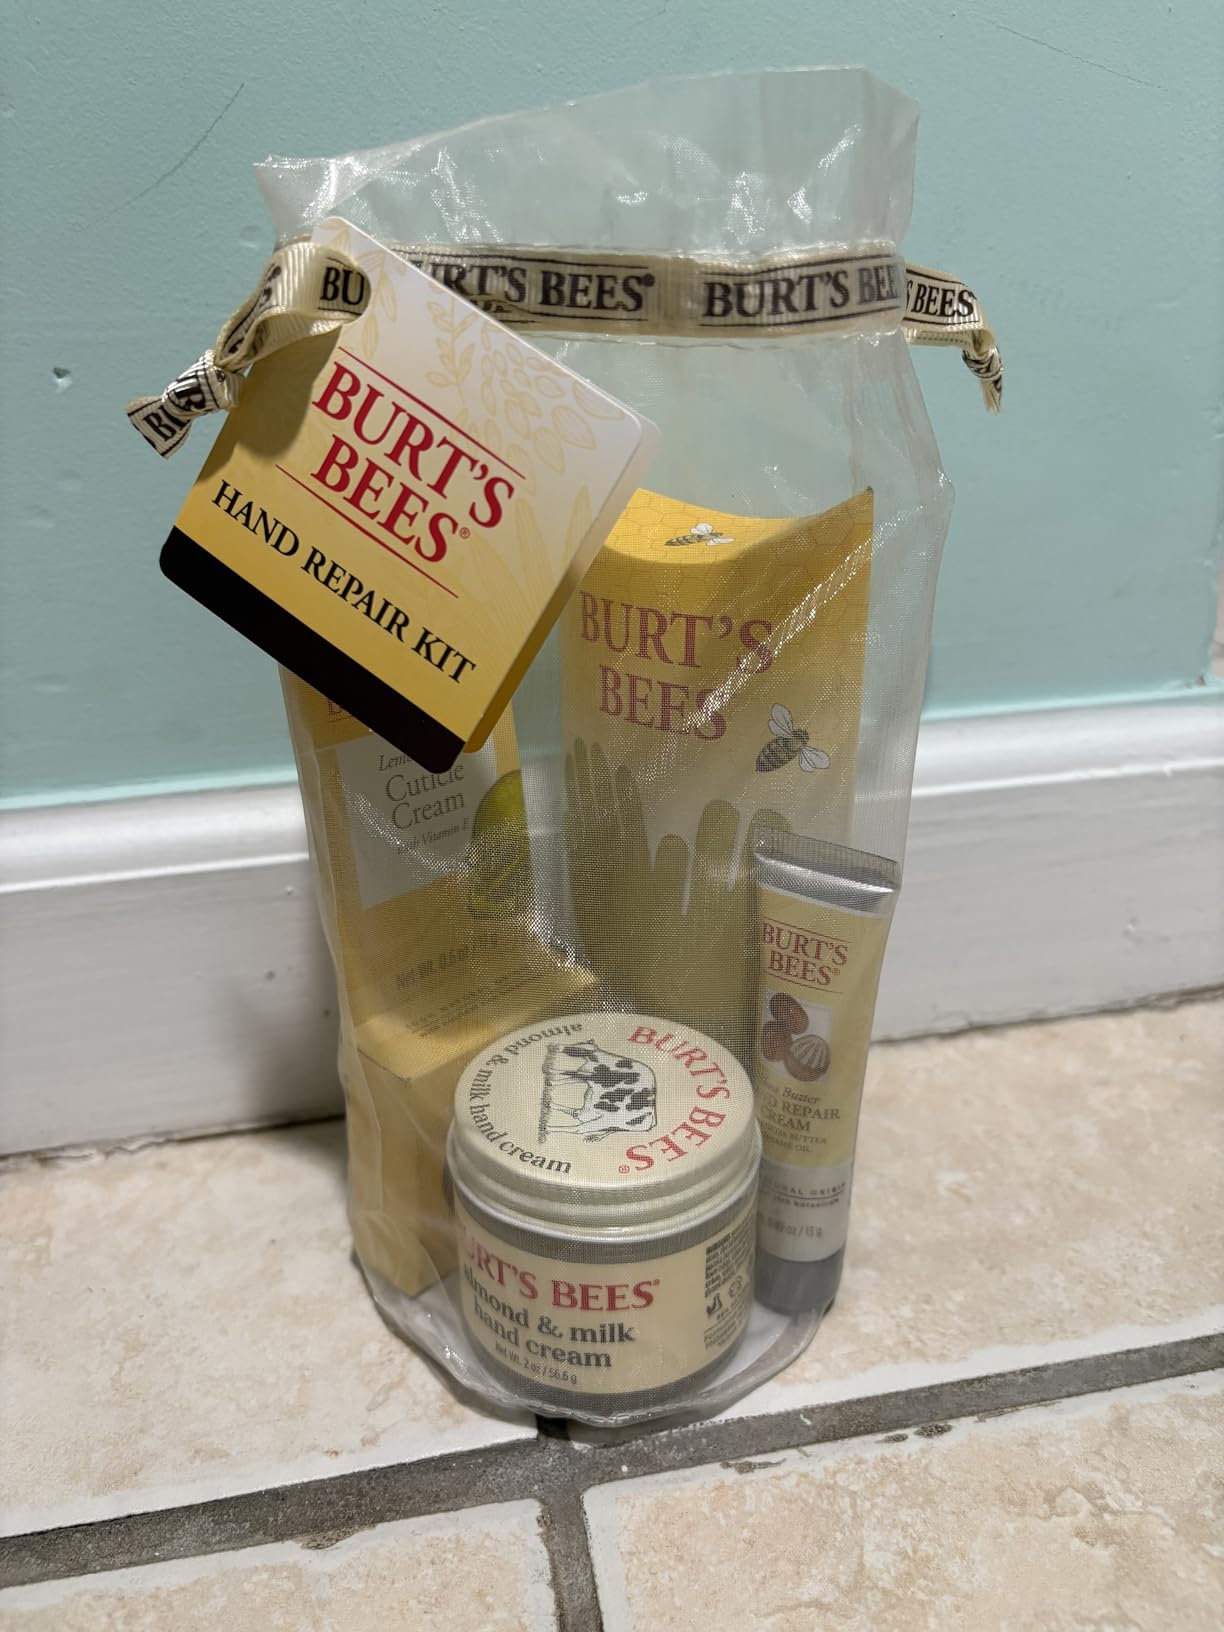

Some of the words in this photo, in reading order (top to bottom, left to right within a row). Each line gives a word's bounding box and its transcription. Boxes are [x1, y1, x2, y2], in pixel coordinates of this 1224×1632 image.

[412, 260, 527, 303] RT'S
[703, 269, 850, 318] BURT'S
[858, 264, 898, 305] BEE
[311, 362, 515, 529] BURT'S
[212, 479, 300, 557] HAND
[300, 546, 411, 642] REPAIR
[411, 627, 477, 684] KIT
[579, 590, 774, 674] BURT'S
[599, 663, 727, 741] BEES
[391, 792, 465, 830] Cream
[762, 921, 849, 966] BURT'S
[502, 1022, 583, 1056] almond
[468, 1068, 493, 1102] milk
[627, 1025, 731, 1101] BURT'S
[468, 1102, 502, 1143] hand
[781, 1100, 841, 1120] REPAIR
[499, 1138, 572, 1175] cream
[473, 1296, 520, 1346] hand
[526, 1338, 612, 1368] cream
[537, 1315, 563, 1339] &
[570, 1321, 638, 1345] milk
